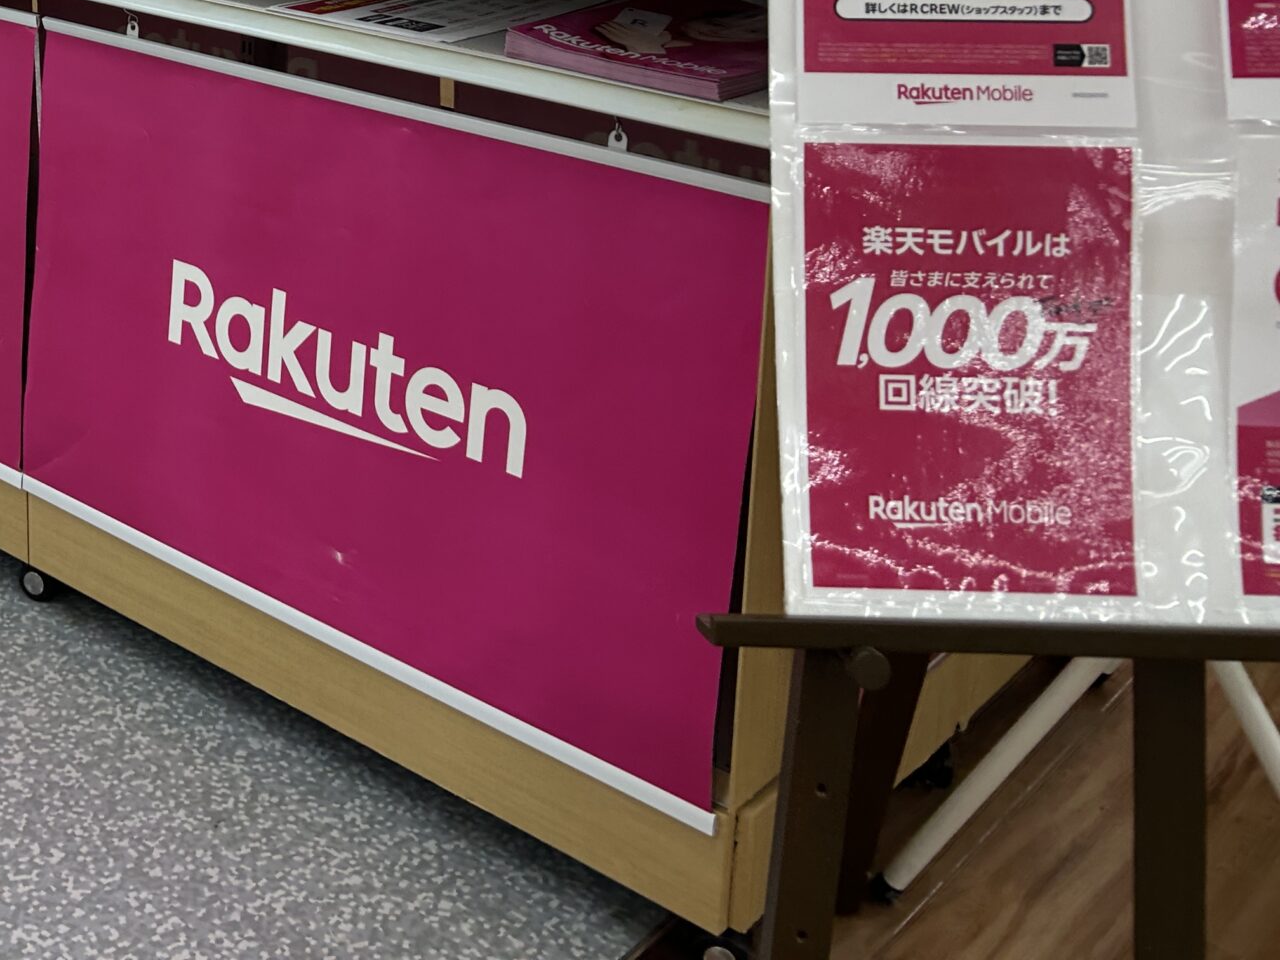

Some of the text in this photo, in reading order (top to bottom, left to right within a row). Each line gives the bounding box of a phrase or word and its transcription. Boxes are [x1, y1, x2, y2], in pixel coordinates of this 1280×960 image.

[533, 23, 728, 76] Rakuten Mobile
[897, 83, 1033, 104] Rakuten Mobile
[862, 225, 1072, 259] 楽天モバイルは
[890, 270, 1055, 290] 皆さまに支えられて
[828, 277, 1097, 371] 1,000万
[168, 258, 527, 479] Rakuten
[879, 374, 1059, 416] 回線突破!
[869, 496, 1072, 527] Rakuten Mobile
